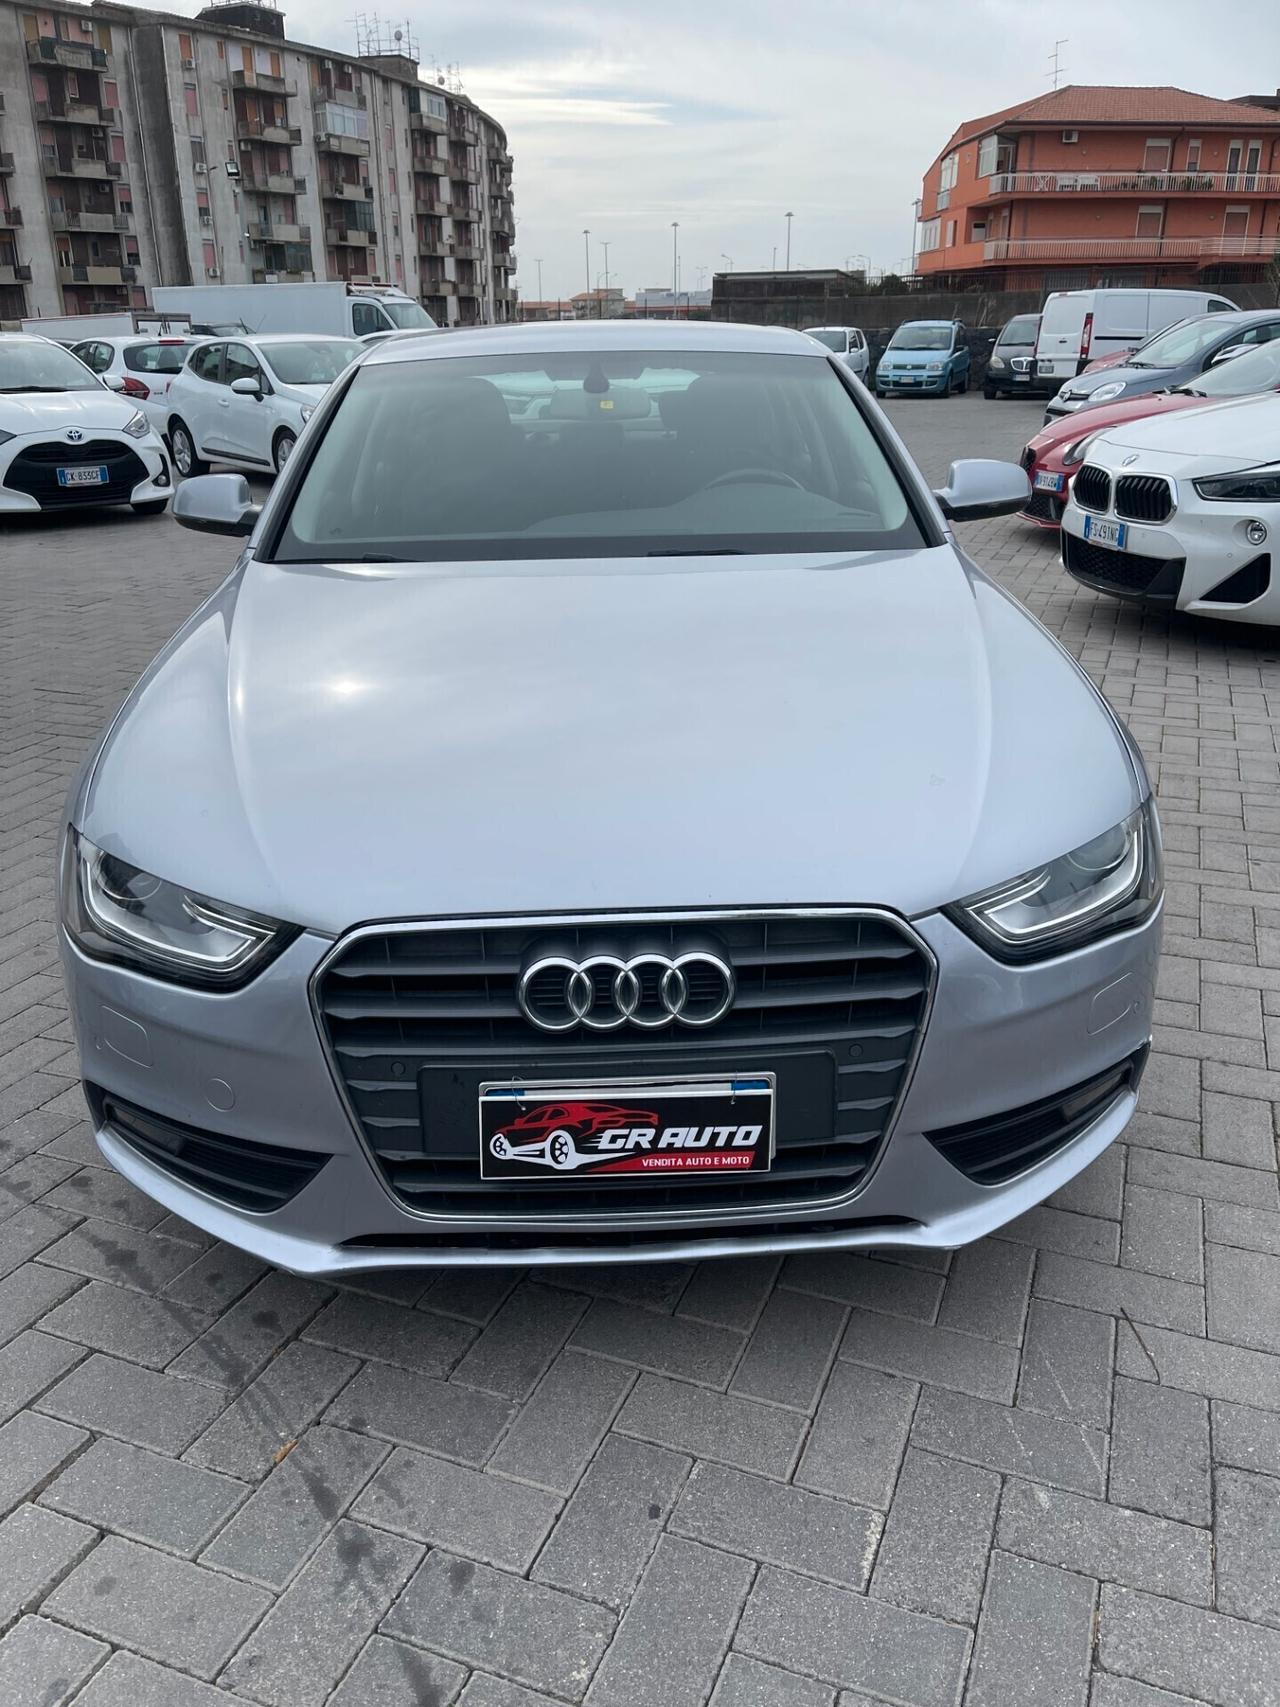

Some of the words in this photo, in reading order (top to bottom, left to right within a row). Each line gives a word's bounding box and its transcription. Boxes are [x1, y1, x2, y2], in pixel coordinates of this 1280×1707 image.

[598, 1128, 656, 1149] GR
[657, 1125, 763, 1149] AUTO
[642, 1158, 683, 1167] VENDITA
[686, 1157, 712, 1166] AUTO
[714, 1157, 720, 1165] E
[721, 1156, 750, 1165] MOTO
